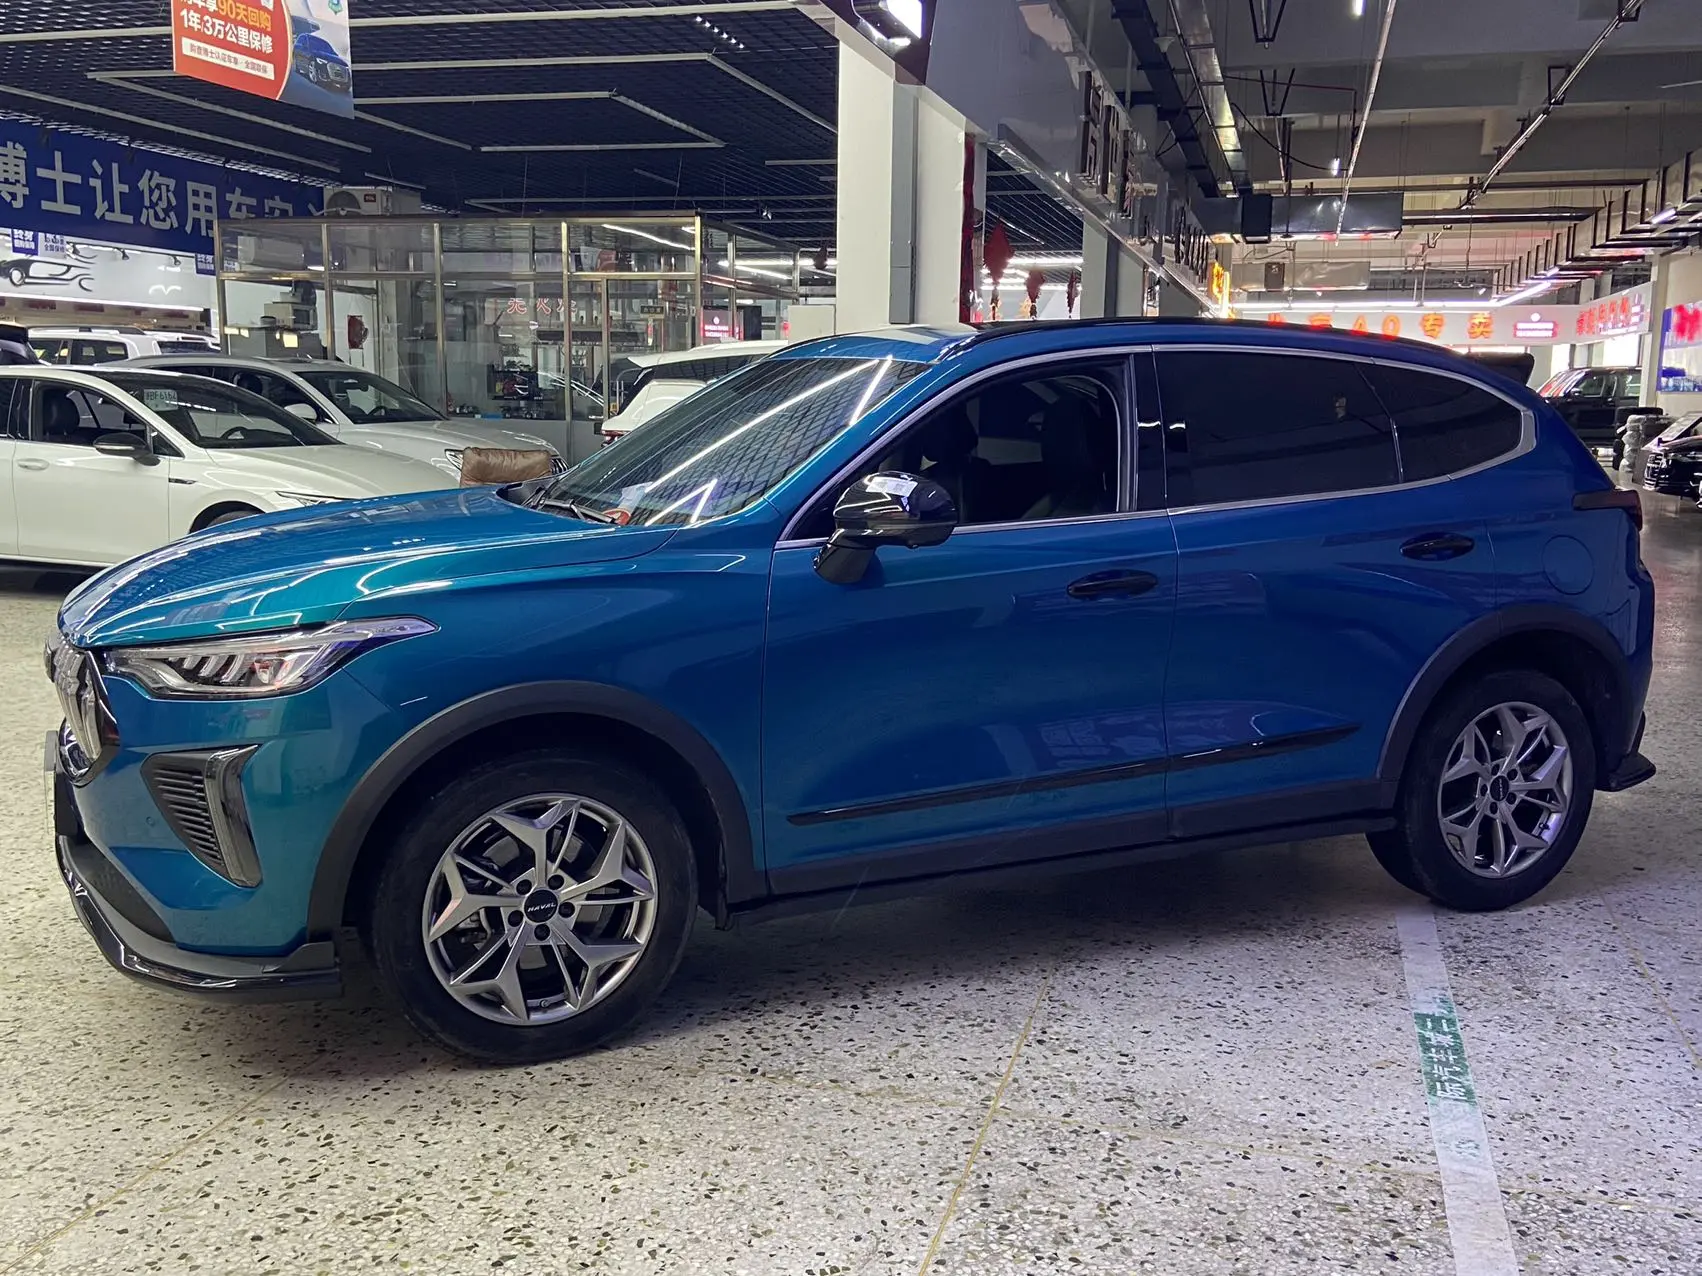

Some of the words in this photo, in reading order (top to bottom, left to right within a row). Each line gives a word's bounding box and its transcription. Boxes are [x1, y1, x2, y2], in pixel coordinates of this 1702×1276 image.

[181, 0, 272, 31] 享90天回购
[527, 902, 556, 912] HAVAL
